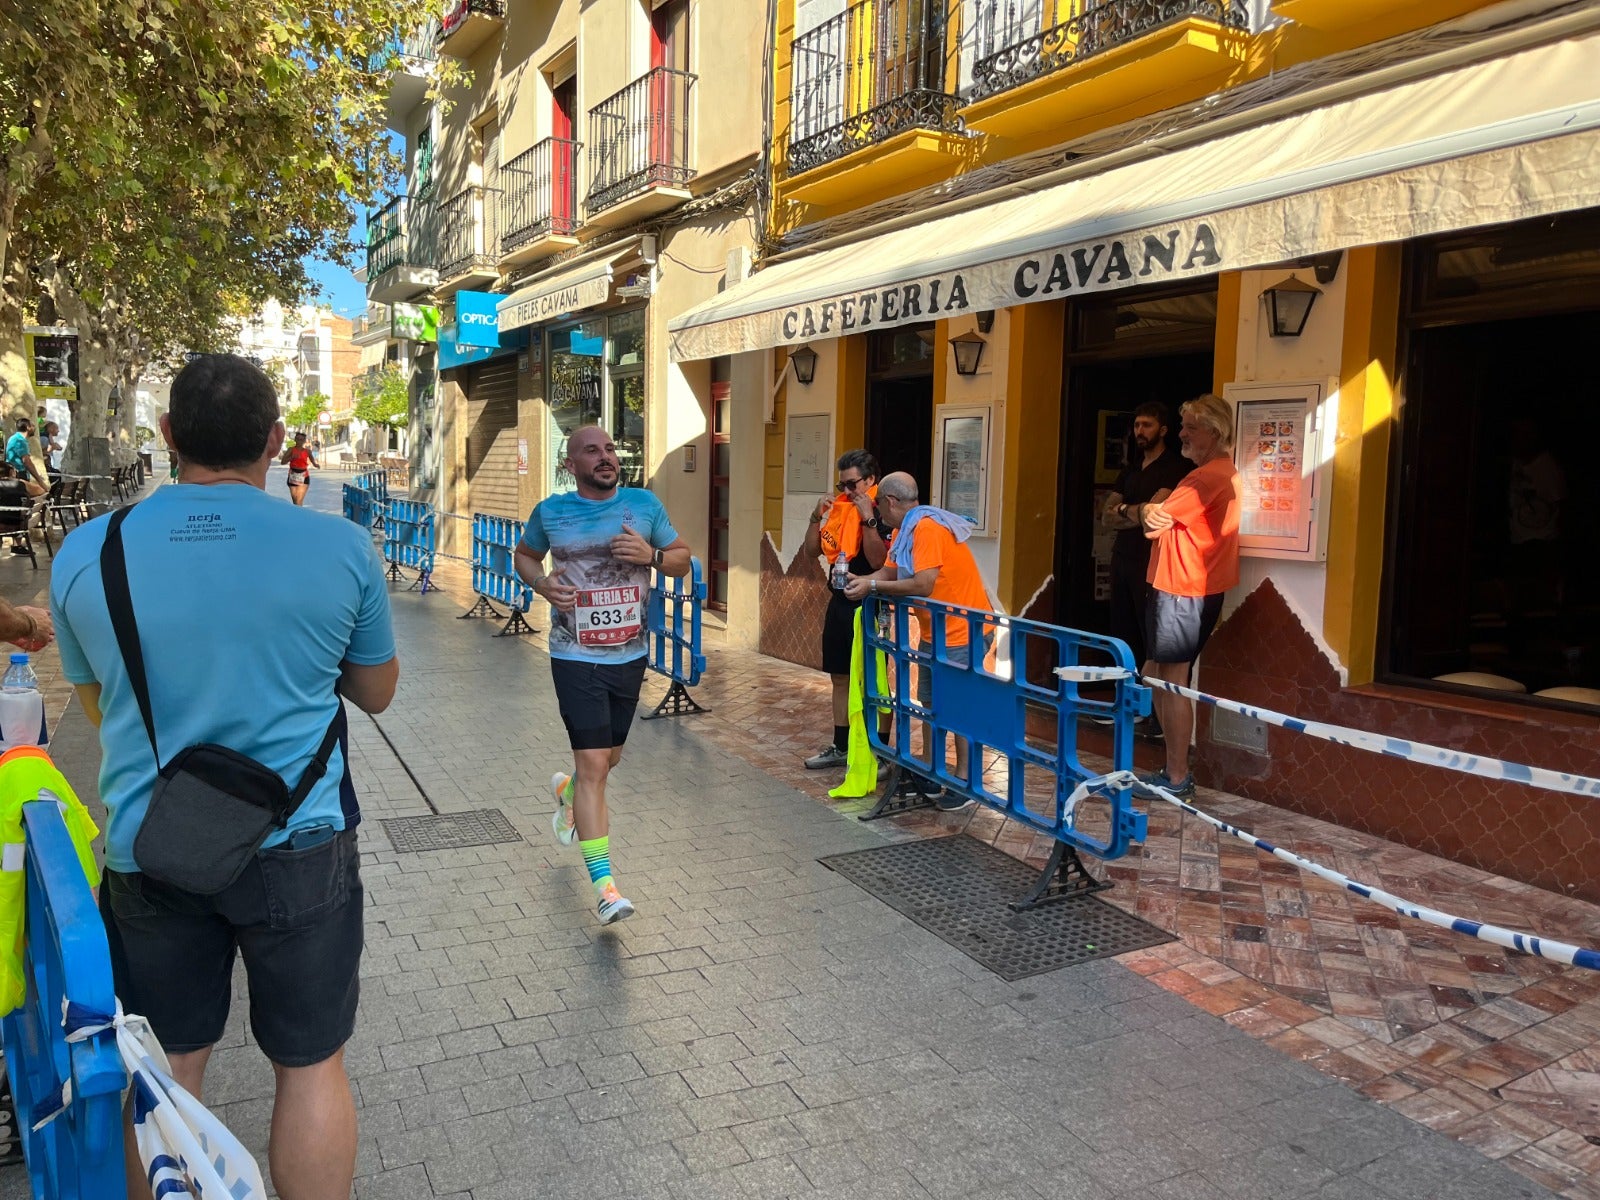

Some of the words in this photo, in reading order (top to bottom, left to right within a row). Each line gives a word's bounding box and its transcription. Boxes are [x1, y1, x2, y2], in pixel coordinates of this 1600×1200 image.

[783, 275, 969, 339] CAFETERIA
[1014, 223, 1221, 298] CAVANA
[517, 299, 539, 323] PIELES
[541, 288, 579, 315] CAVANA
[570, 366, 592, 384] PIELES
[565, 382, 599, 400] CAVANA
[188, 513, 221, 522] nerja
[591, 590, 621, 606] NERJA
[622, 588, 636, 603] 5K
[590, 609, 622, 626] 633
